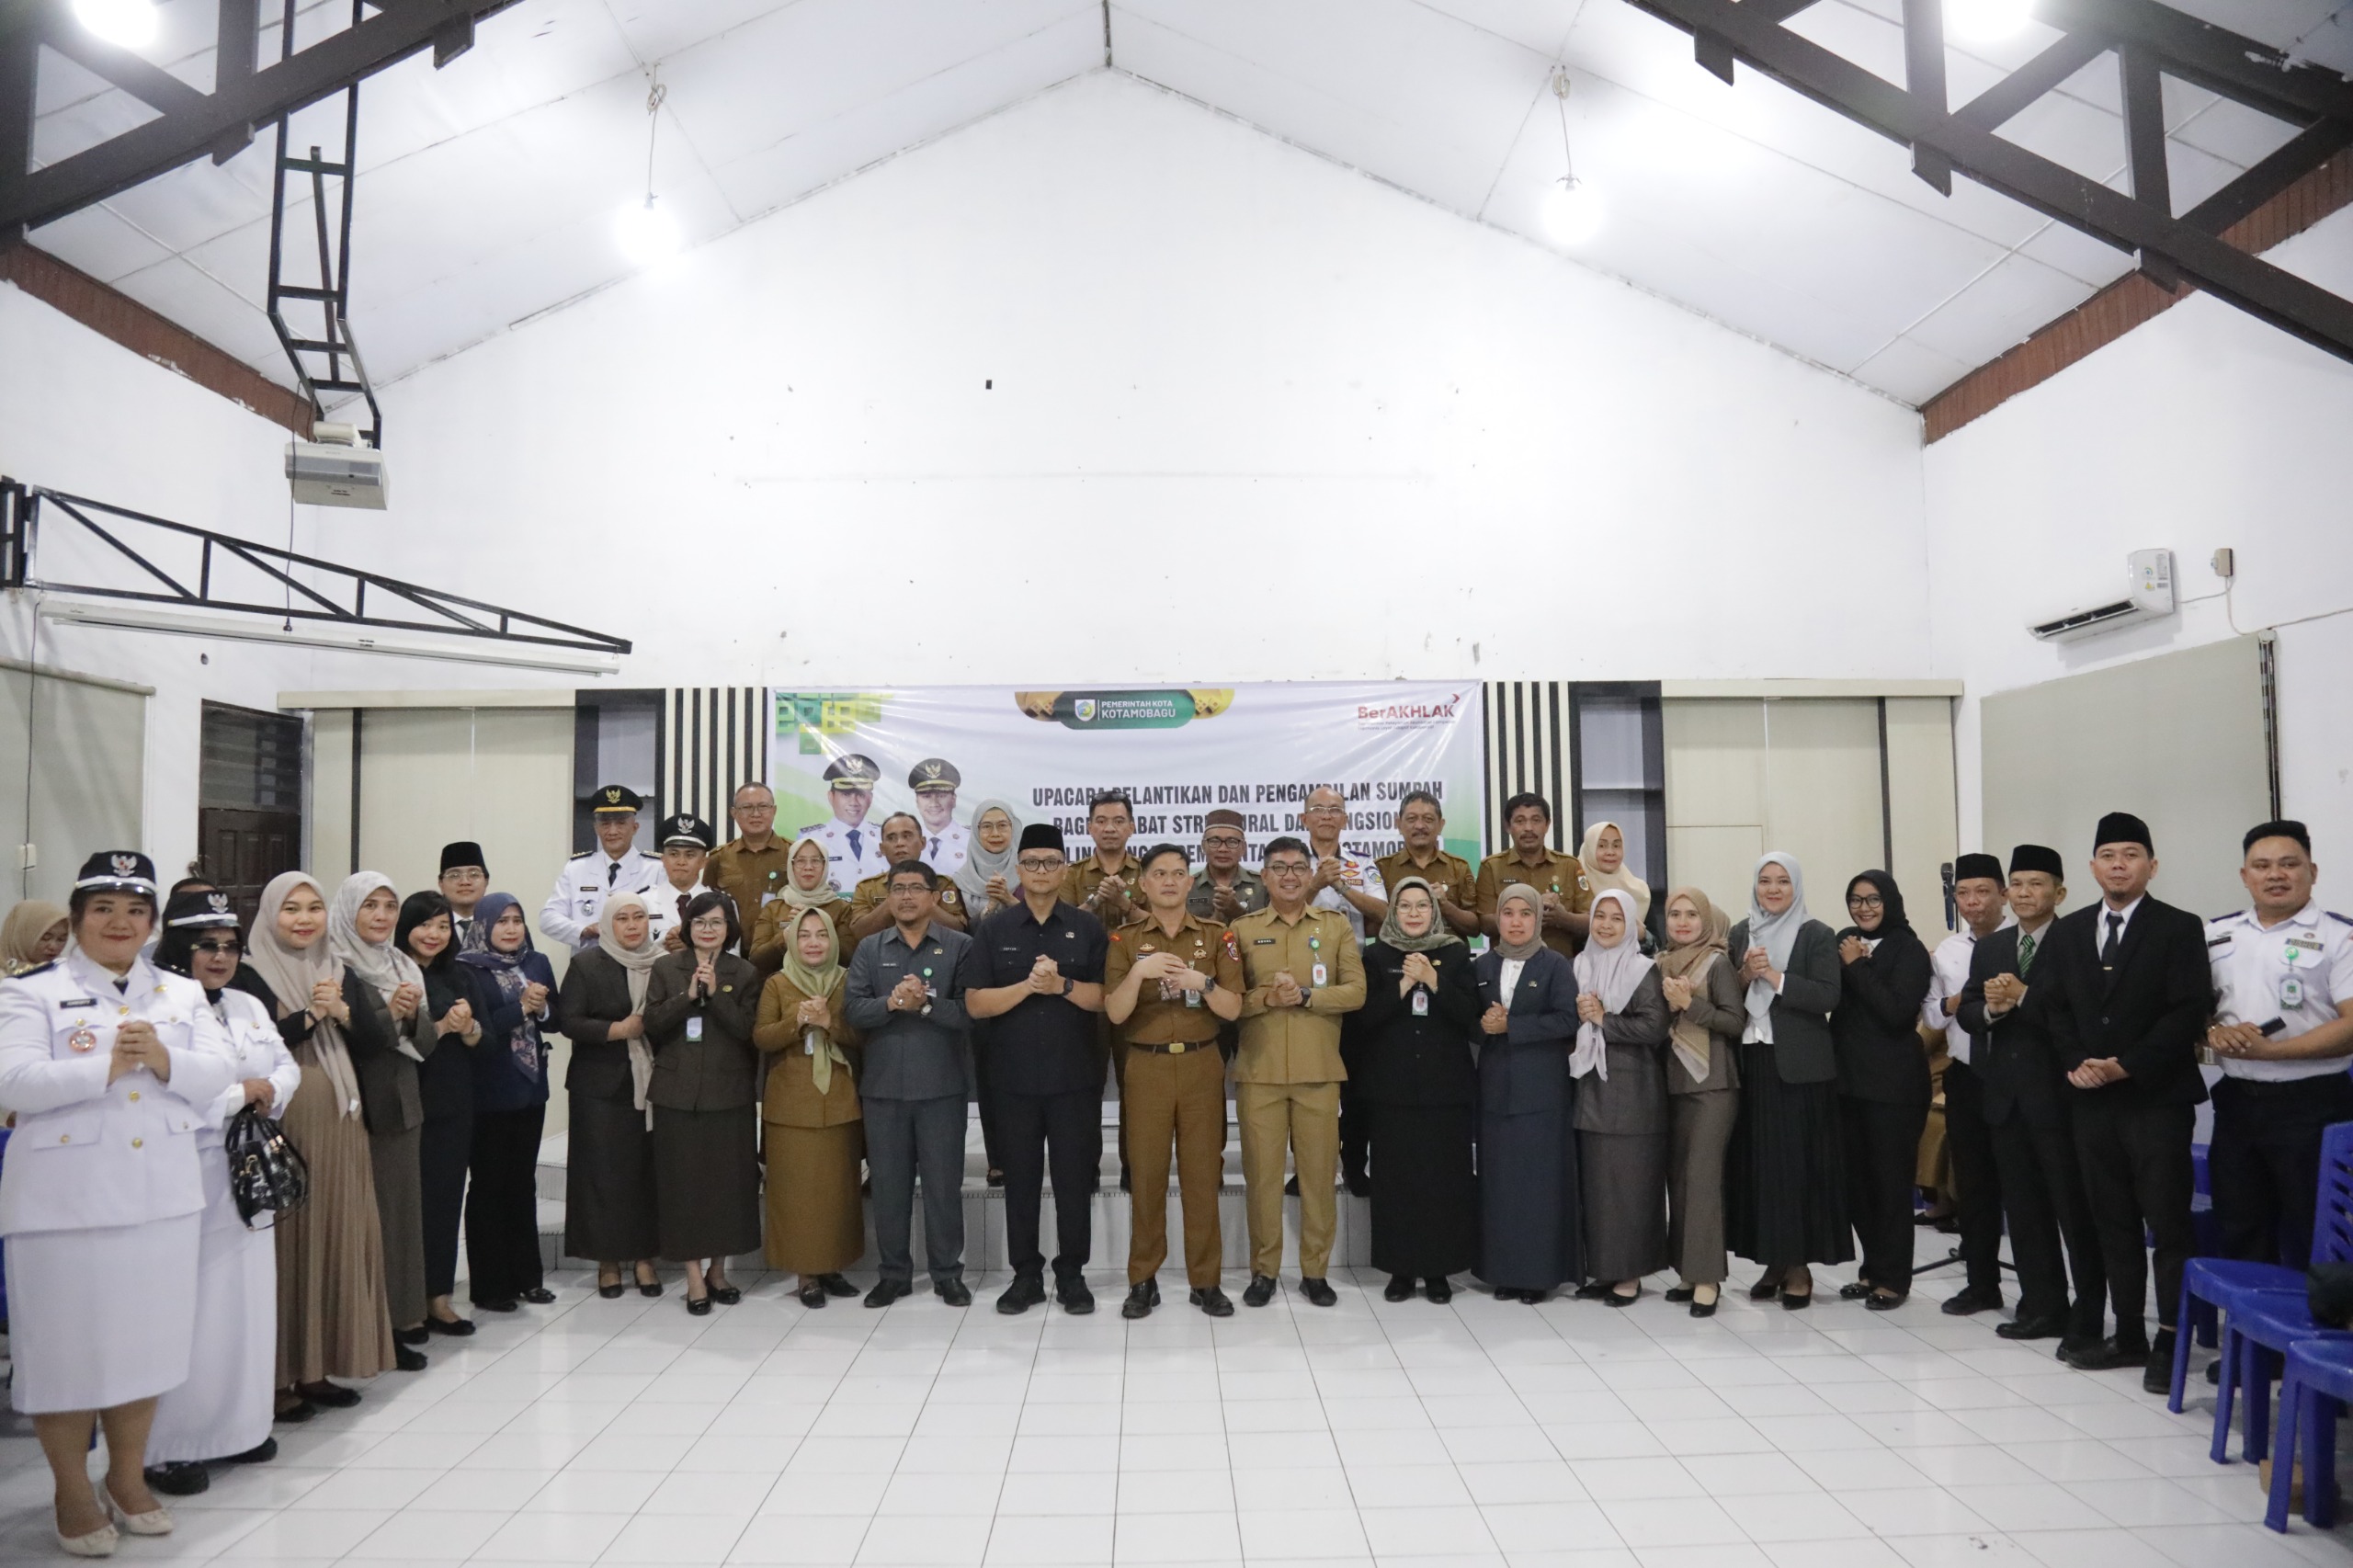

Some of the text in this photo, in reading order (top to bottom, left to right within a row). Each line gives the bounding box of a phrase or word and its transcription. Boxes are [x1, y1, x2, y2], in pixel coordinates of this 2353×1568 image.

[1102, 709, 1176, 718] KOTAMOBAGU
[1358, 705, 1454, 719] BerAKHLAK
[1219, 785, 1249, 803] DAN
